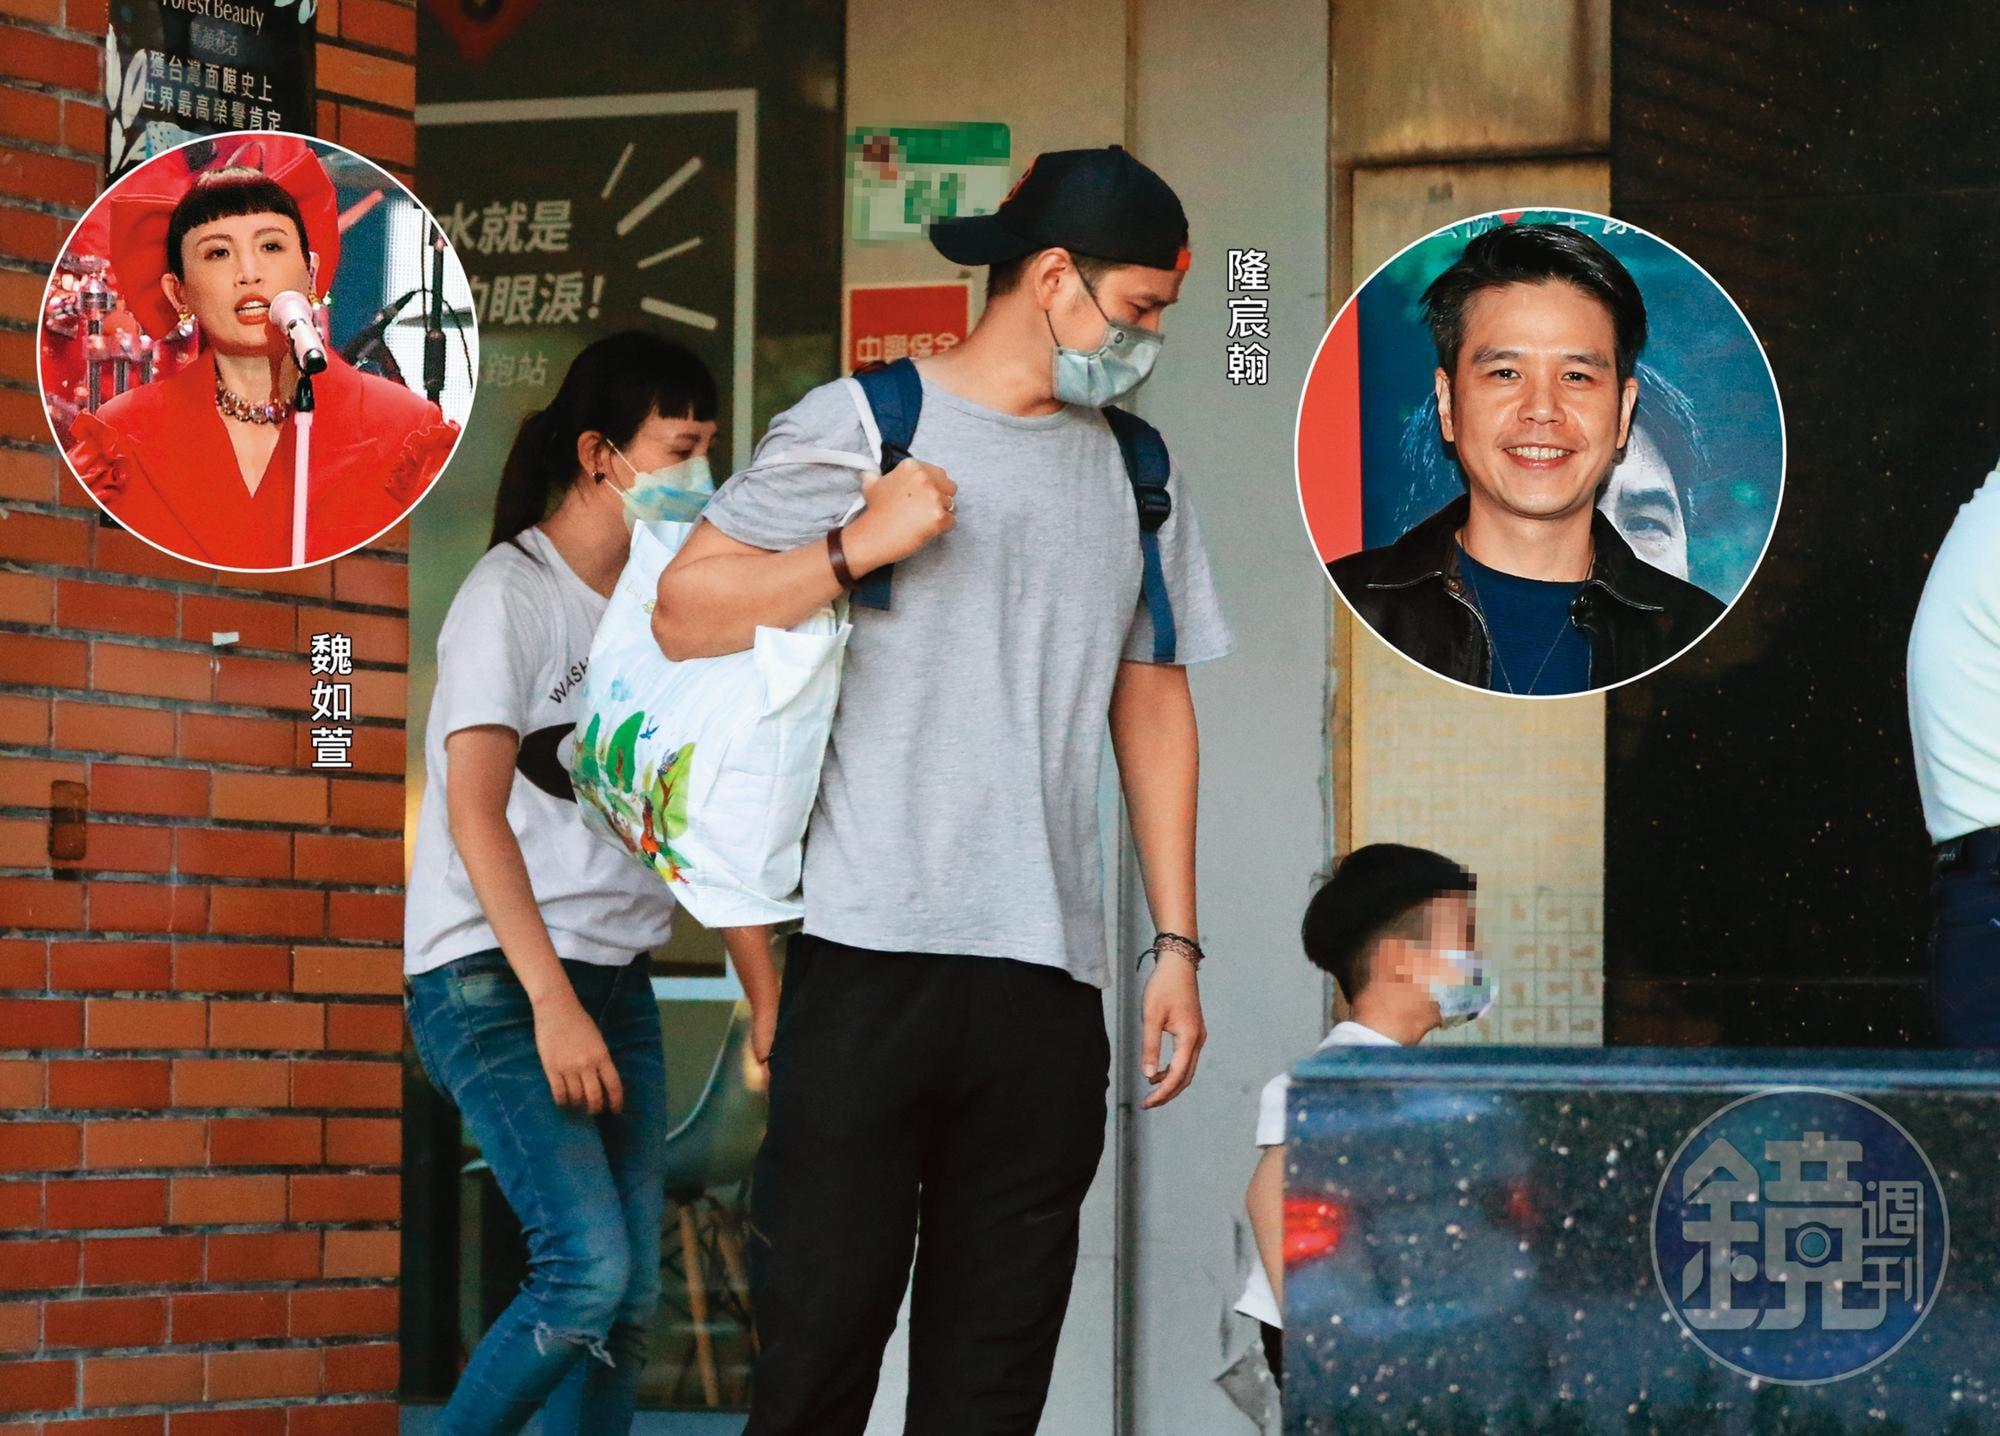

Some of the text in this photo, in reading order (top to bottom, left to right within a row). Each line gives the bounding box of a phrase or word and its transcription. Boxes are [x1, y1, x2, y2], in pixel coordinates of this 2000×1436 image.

[214, 0, 264, 36] Beauty
[150, 49, 273, 103] 獲台灣面膜史上
[141, 82, 282, 131] 世界最高榮譽肯定
